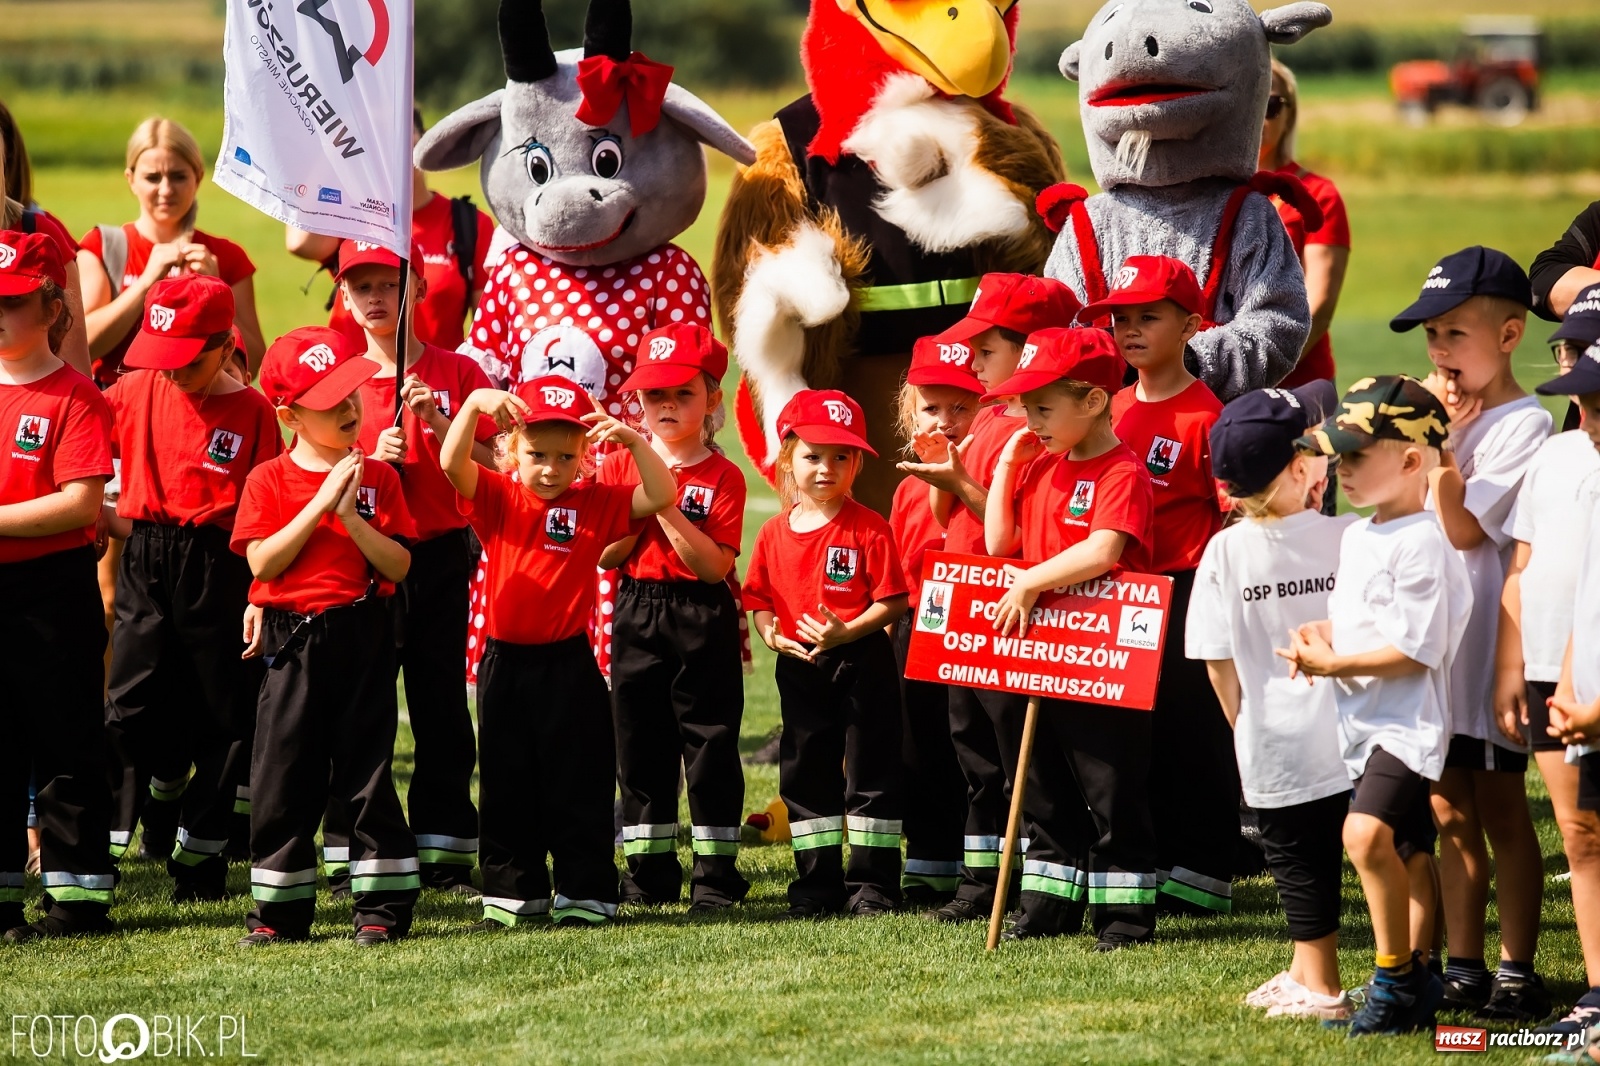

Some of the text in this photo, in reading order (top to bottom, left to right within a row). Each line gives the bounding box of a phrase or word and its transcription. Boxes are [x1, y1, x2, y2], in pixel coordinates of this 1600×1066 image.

[932, 562, 1026, 590] DZIECI
[1243, 572, 1336, 601] OSP BOJANÓ
[969, 600, 1111, 634] PORNICZA
[943, 631, 1130, 670] OSP WIERUSZÓW
[1119, 637, 1157, 648] WIERUSZÓW
[938, 663, 1125, 700] GMINA WIERUSZÓW
